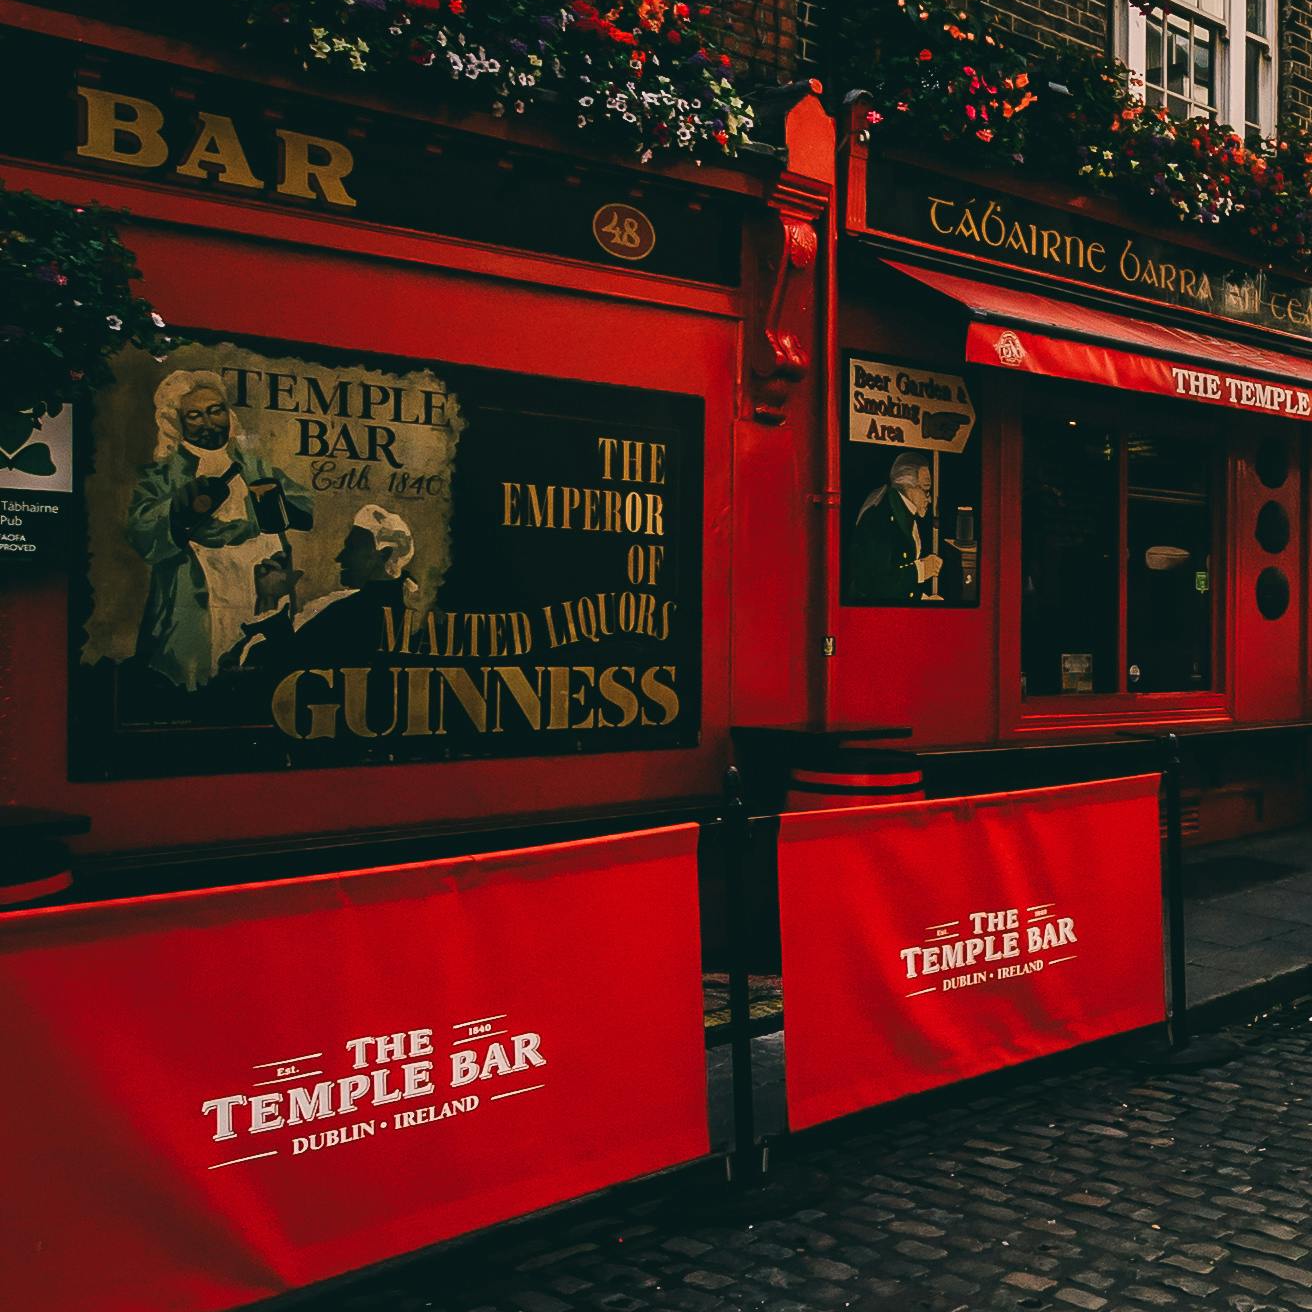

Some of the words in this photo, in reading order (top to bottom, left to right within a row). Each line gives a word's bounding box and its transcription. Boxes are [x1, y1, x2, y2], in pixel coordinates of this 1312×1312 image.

[77, 86, 357, 207] BAR
[601, 211, 641, 248] 48
[222, 367, 450, 427] TEMPLE
[854, 365, 891, 392] Beer
[896, 373, 952, 401] Garden
[1172, 368, 1221, 399] THE
[1226, 377, 1311, 416] TEMPLE
[854, 391, 920, 425] Smoking
[867, 419, 904, 443] Area
[295, 418, 404, 469] BAR
[599, 438, 666, 485] THE
[1, 500, 60, 514] Tábhairne
[387, 471, 446, 497] 1840
[0, 516, 23, 526] Pub
[502, 482, 665, 536] EMPEROR
[0, 533, 26, 541] AOFA
[627, 544, 665, 585] OF
[377, 606, 533, 657] MALTED
[543, 591, 678, 648] LIQUORS
[271, 666, 680, 739] GUINNESS
[970, 909, 1019, 935] THE
[900, 932, 1020, 978] TEMPLE
[1027, 917, 1077, 953] BAR
[942, 971, 987, 991] DUBLIN
[997, 959, 1044, 980] IRELAND
[277, 1066, 300, 1077] Est.
[346, 1028, 434, 1070] THE
[468, 1023, 492, 1036] 1840
[201, 1061, 435, 1142] TEMPLE
[450, 1033, 546, 1088] BAR
[292, 1120, 375, 1155] DUBLIN
[394, 1095, 480, 1130] IRELAND
